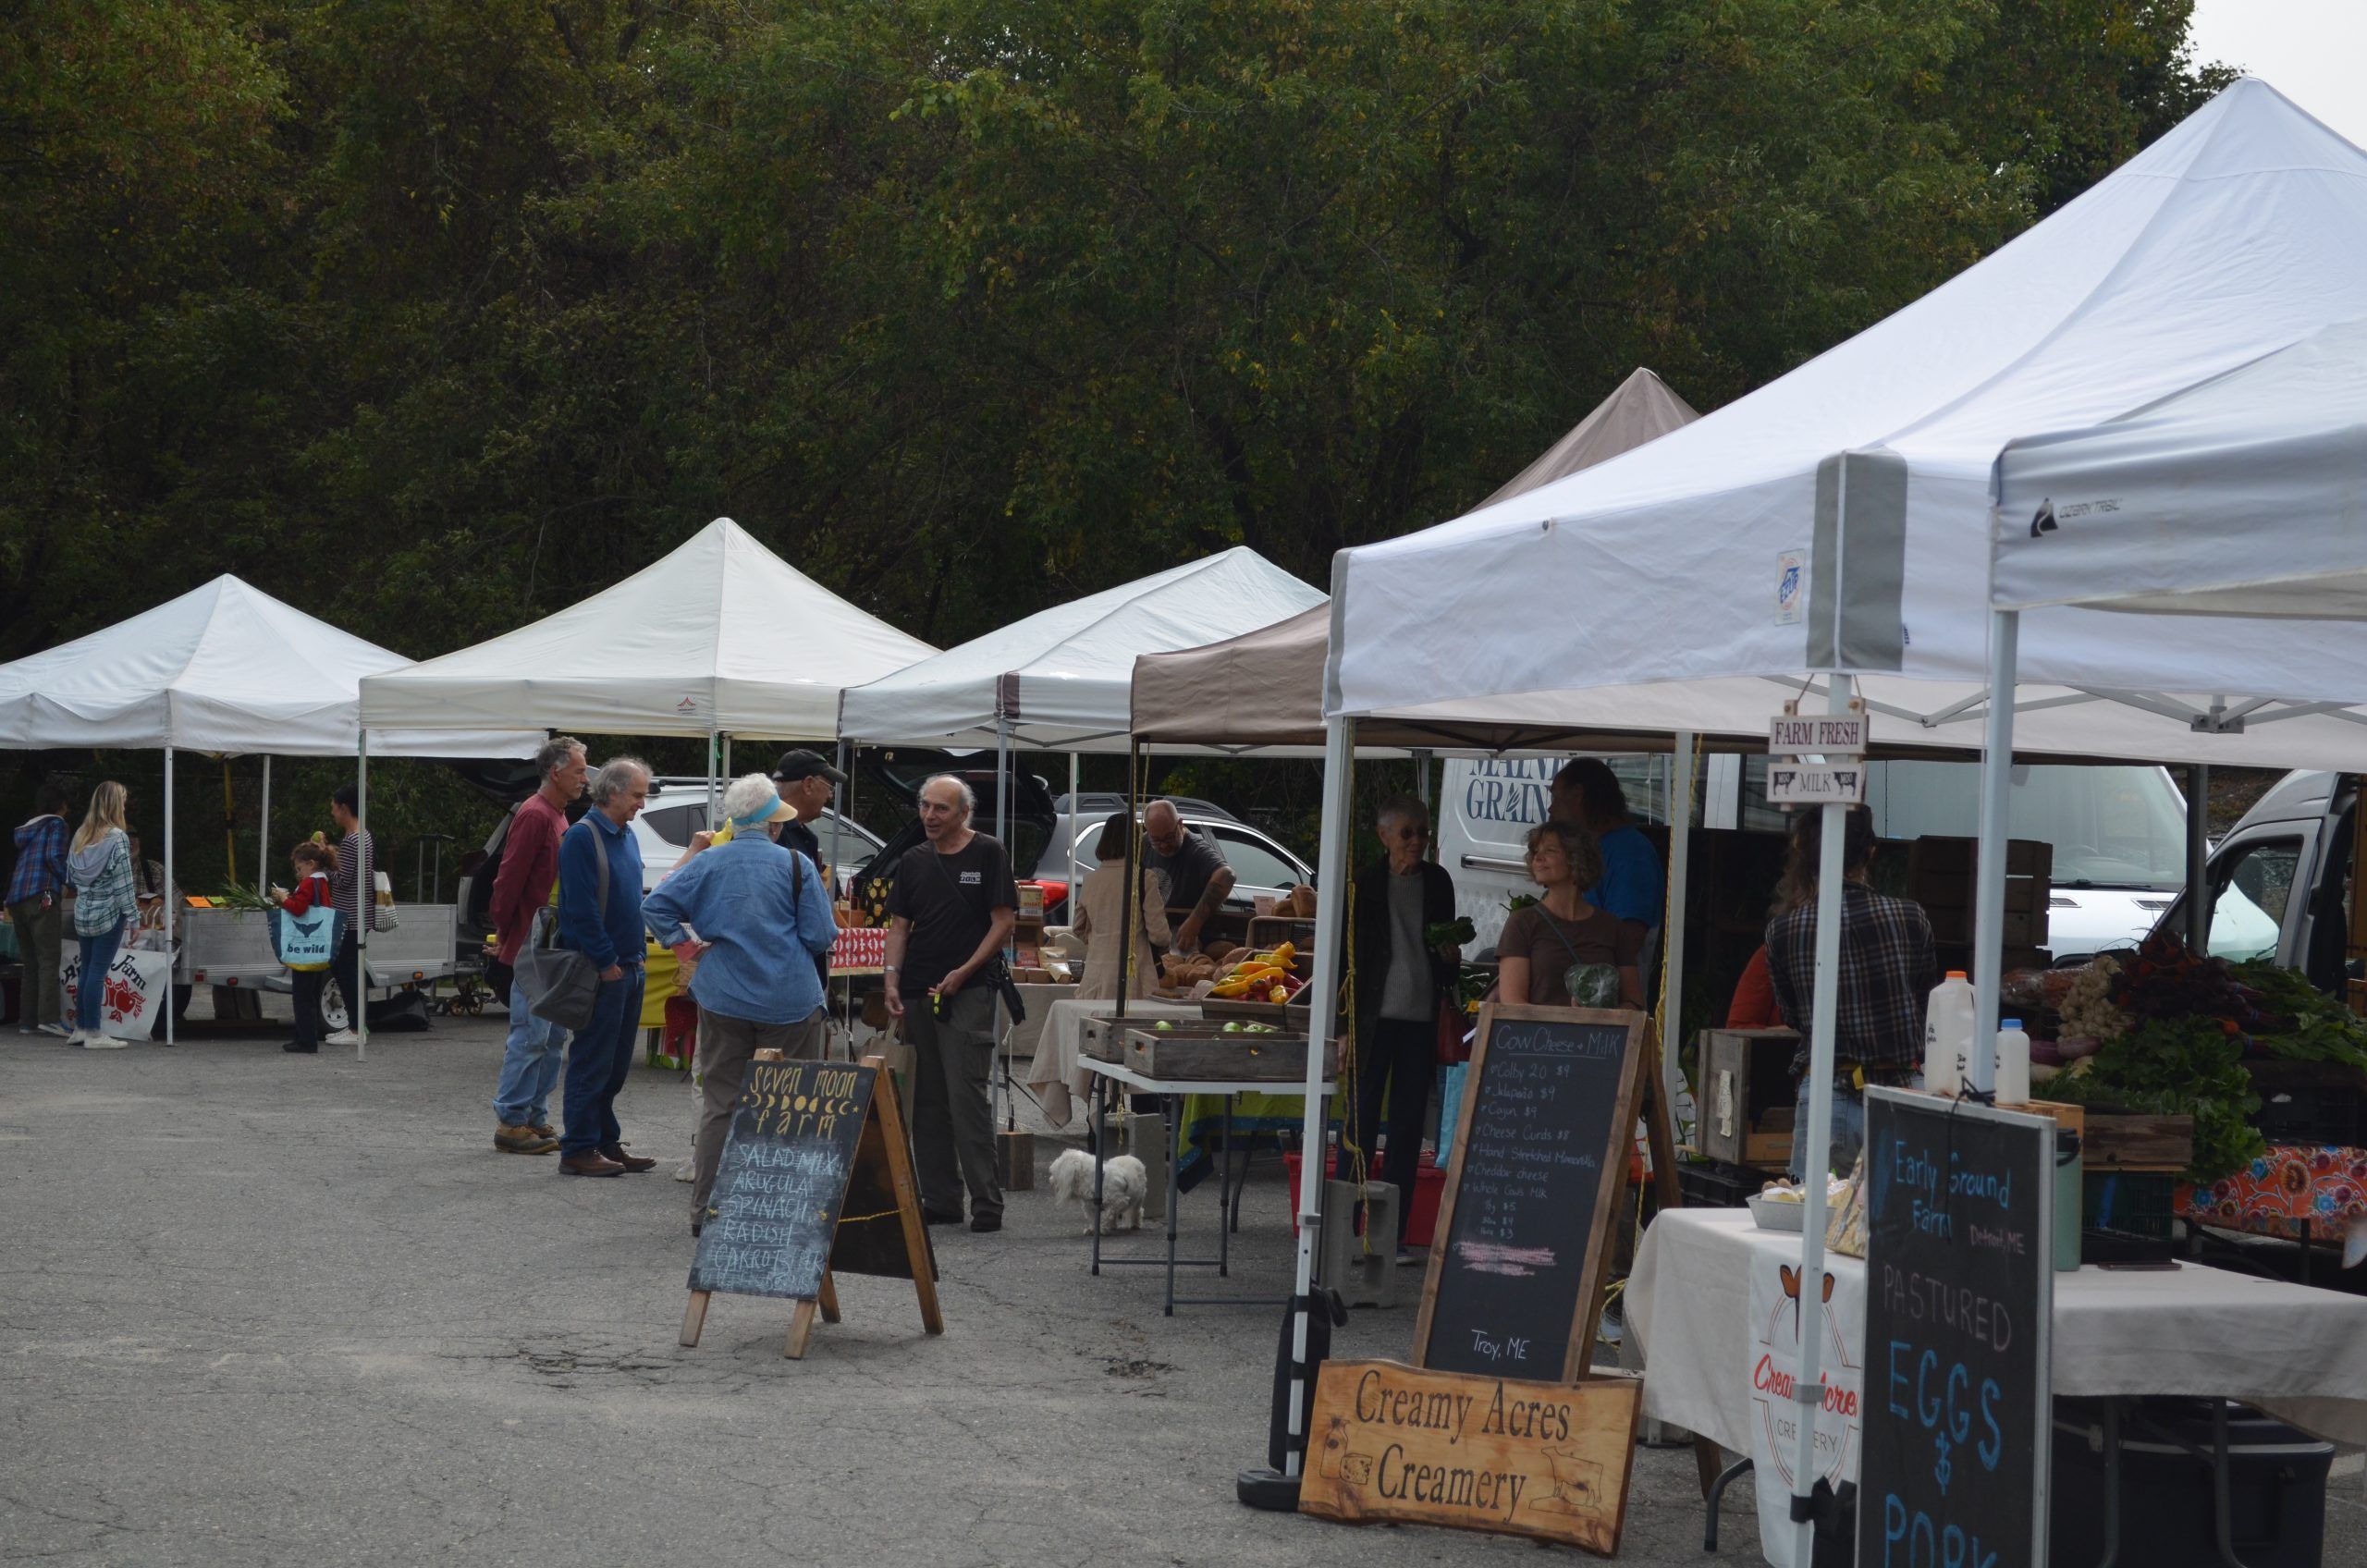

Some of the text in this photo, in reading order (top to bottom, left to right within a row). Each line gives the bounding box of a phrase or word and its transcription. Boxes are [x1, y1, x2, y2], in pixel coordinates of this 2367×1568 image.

[1774, 722, 1859, 745] FARM FRESH
[1469, 758, 1563, 780] MAIN
[1778, 773, 1853, 792] MOO MILK MOO
[1466, 778, 1552, 824] GRAIN
[288, 943, 325, 954] be wild
[110, 954, 147, 990] Farm
[1496, 1024, 1532, 1050] Cow
[1531, 1026, 1575, 1052] Cheese
[813, 1070, 858, 1098] moon
[1496, 1061, 1570, 1083] Colby 20 $9
[1539, 1085, 1555, 1102] $9
[756, 1109, 837, 1141] farm
[1488, 1102, 1539, 1121] Cajun $9
[1482, 1123, 1571, 1141] Cheese Curds $8
[739, 1143, 840, 1177] SALAD MIX
[1478, 1142, 1505, 1159] Hand
[1511, 1146, 1551, 1163] Stretched
[730, 1170, 810, 1199] ARUGULA
[1473, 1182, 1499, 1195] Whole
[1895, 1140, 2012, 1211] Early Ground
[723, 1194, 809, 1221] SPINACH
[1502, 1202, 1517, 1211] $5
[723, 1218, 793, 1246] RADISH
[1912, 1199, 1954, 1239] Farm
[2007, 1231, 2027, 1256] ME
[1883, 1264, 2012, 1353] PASTURED
[1471, 1329, 1532, 1361] Troy, ME
[1753, 1353, 1797, 1403] Crea
[1355, 1369, 1571, 1445] Creamy Acres
[1889, 1340, 2003, 1472] EGGS
[1777, 1418, 1838, 1452] CREERY
[1378, 1443, 1527, 1525] Creamery
